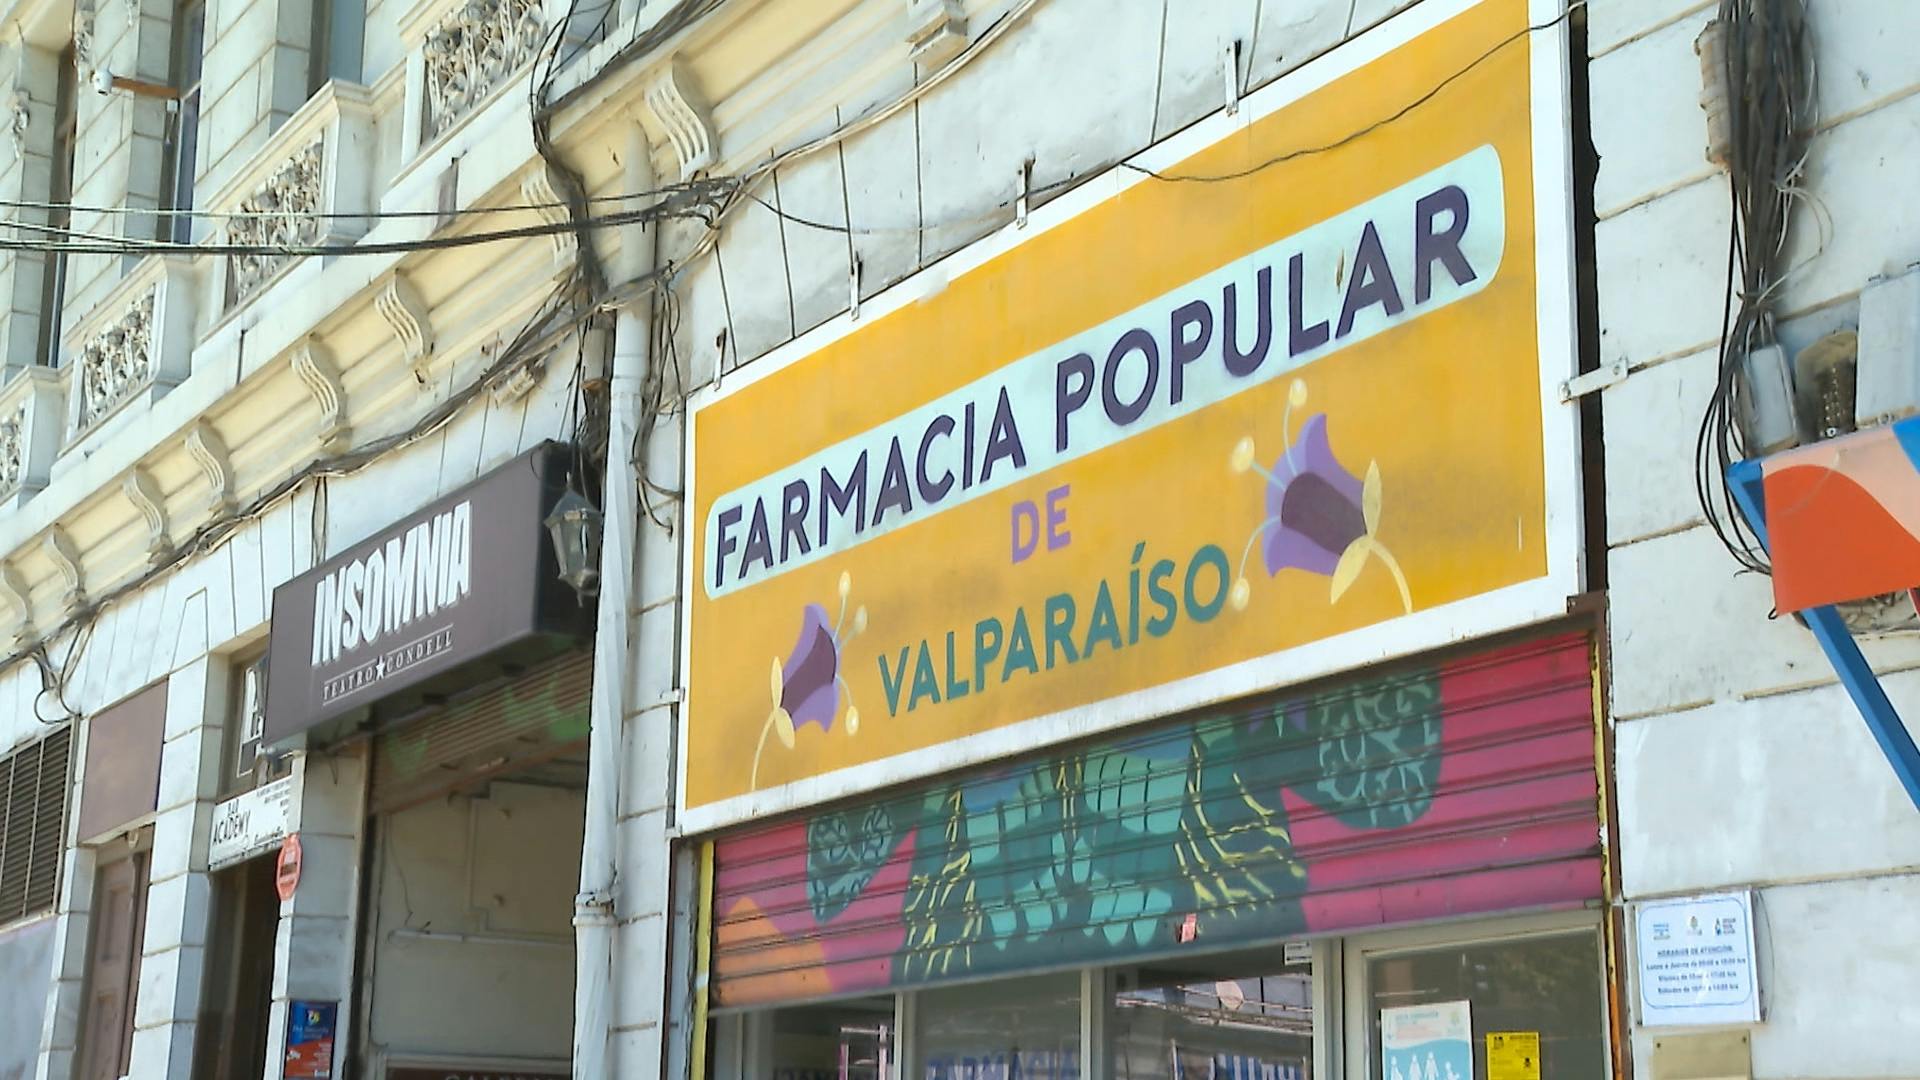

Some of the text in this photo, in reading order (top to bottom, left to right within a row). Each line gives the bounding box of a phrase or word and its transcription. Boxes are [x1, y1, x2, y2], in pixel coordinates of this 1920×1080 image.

[715, 184, 1479, 588] FARMACIA POPULAR
[311, 499, 471, 667] INSOMNIA
[1010, 484, 1071, 565] DE
[322, 630, 454, 701] TEATRO CONDELL
[878, 541, 1231, 719] VALPARAÍSO
[211, 809, 252, 846] ACADEMY
